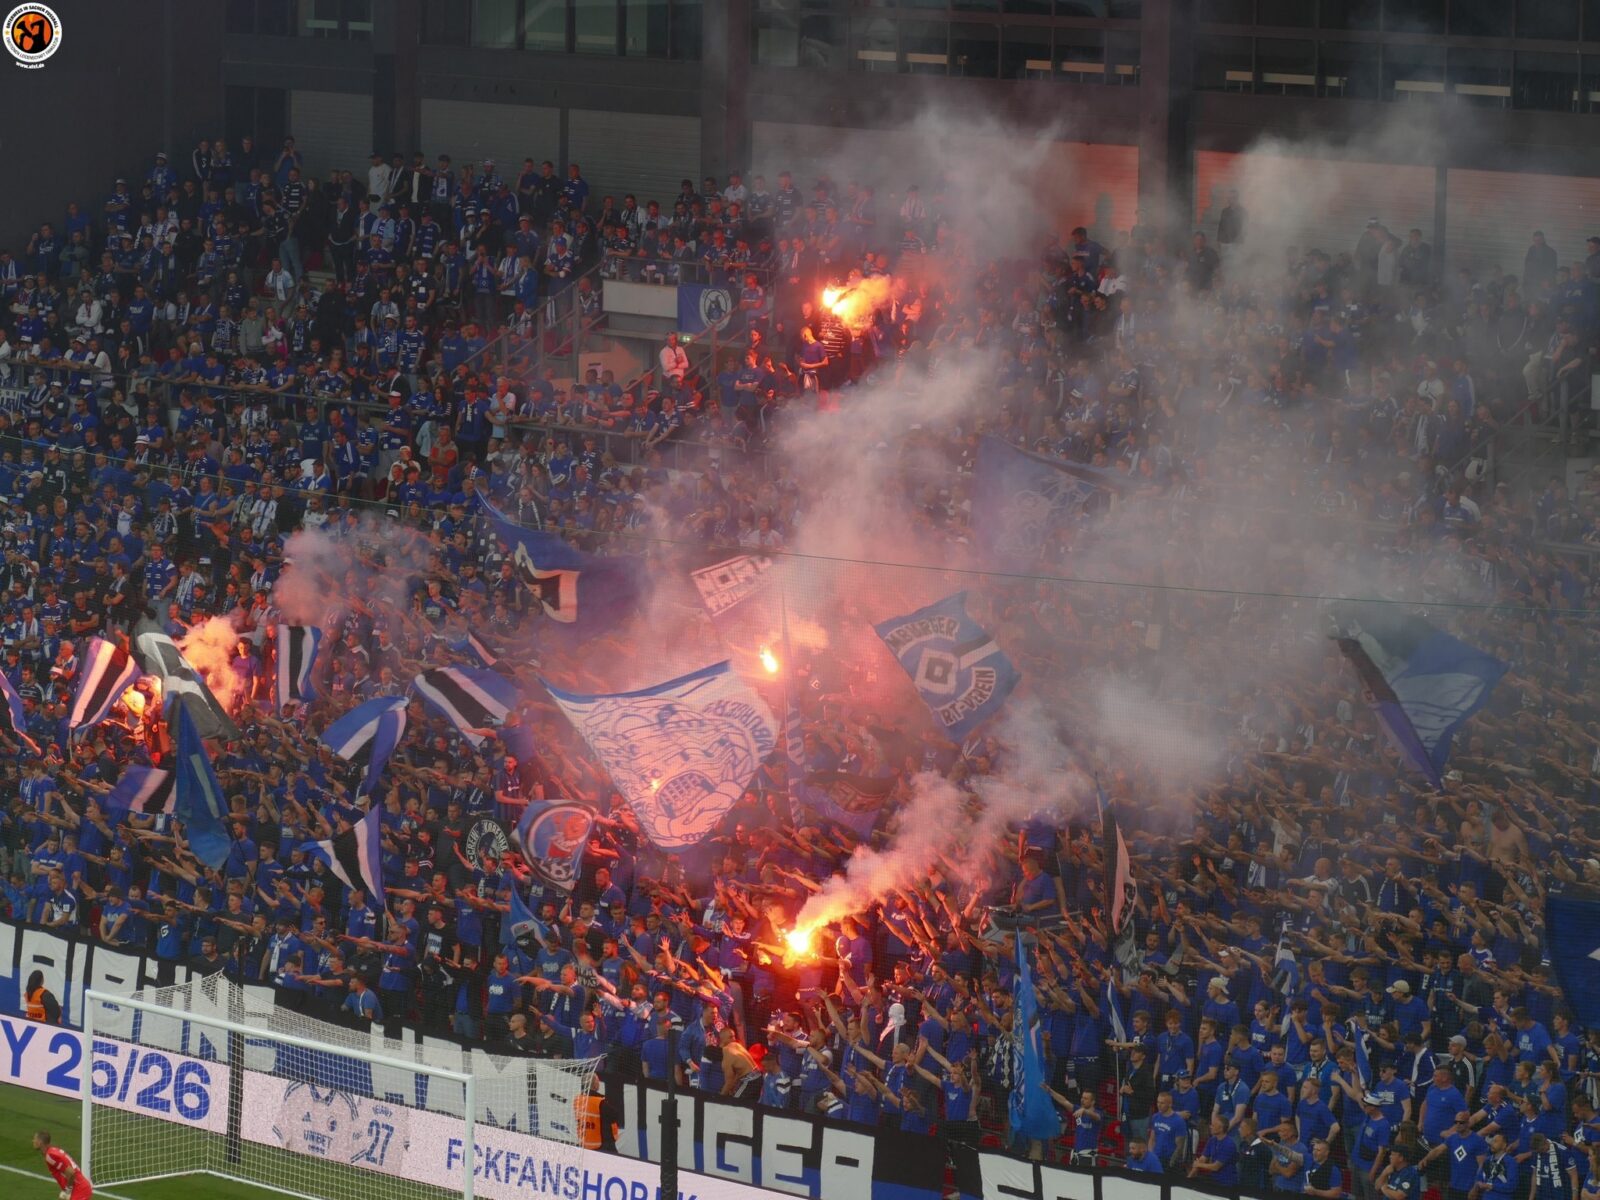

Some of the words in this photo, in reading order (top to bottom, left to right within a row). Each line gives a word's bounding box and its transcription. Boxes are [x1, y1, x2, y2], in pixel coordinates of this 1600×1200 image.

[887, 615, 961, 650] MBURGER
[940, 668, 996, 726] RT-VEREIN
[46, 1031, 212, 1121] 25/26
[365, 1119, 395, 1166] 27
